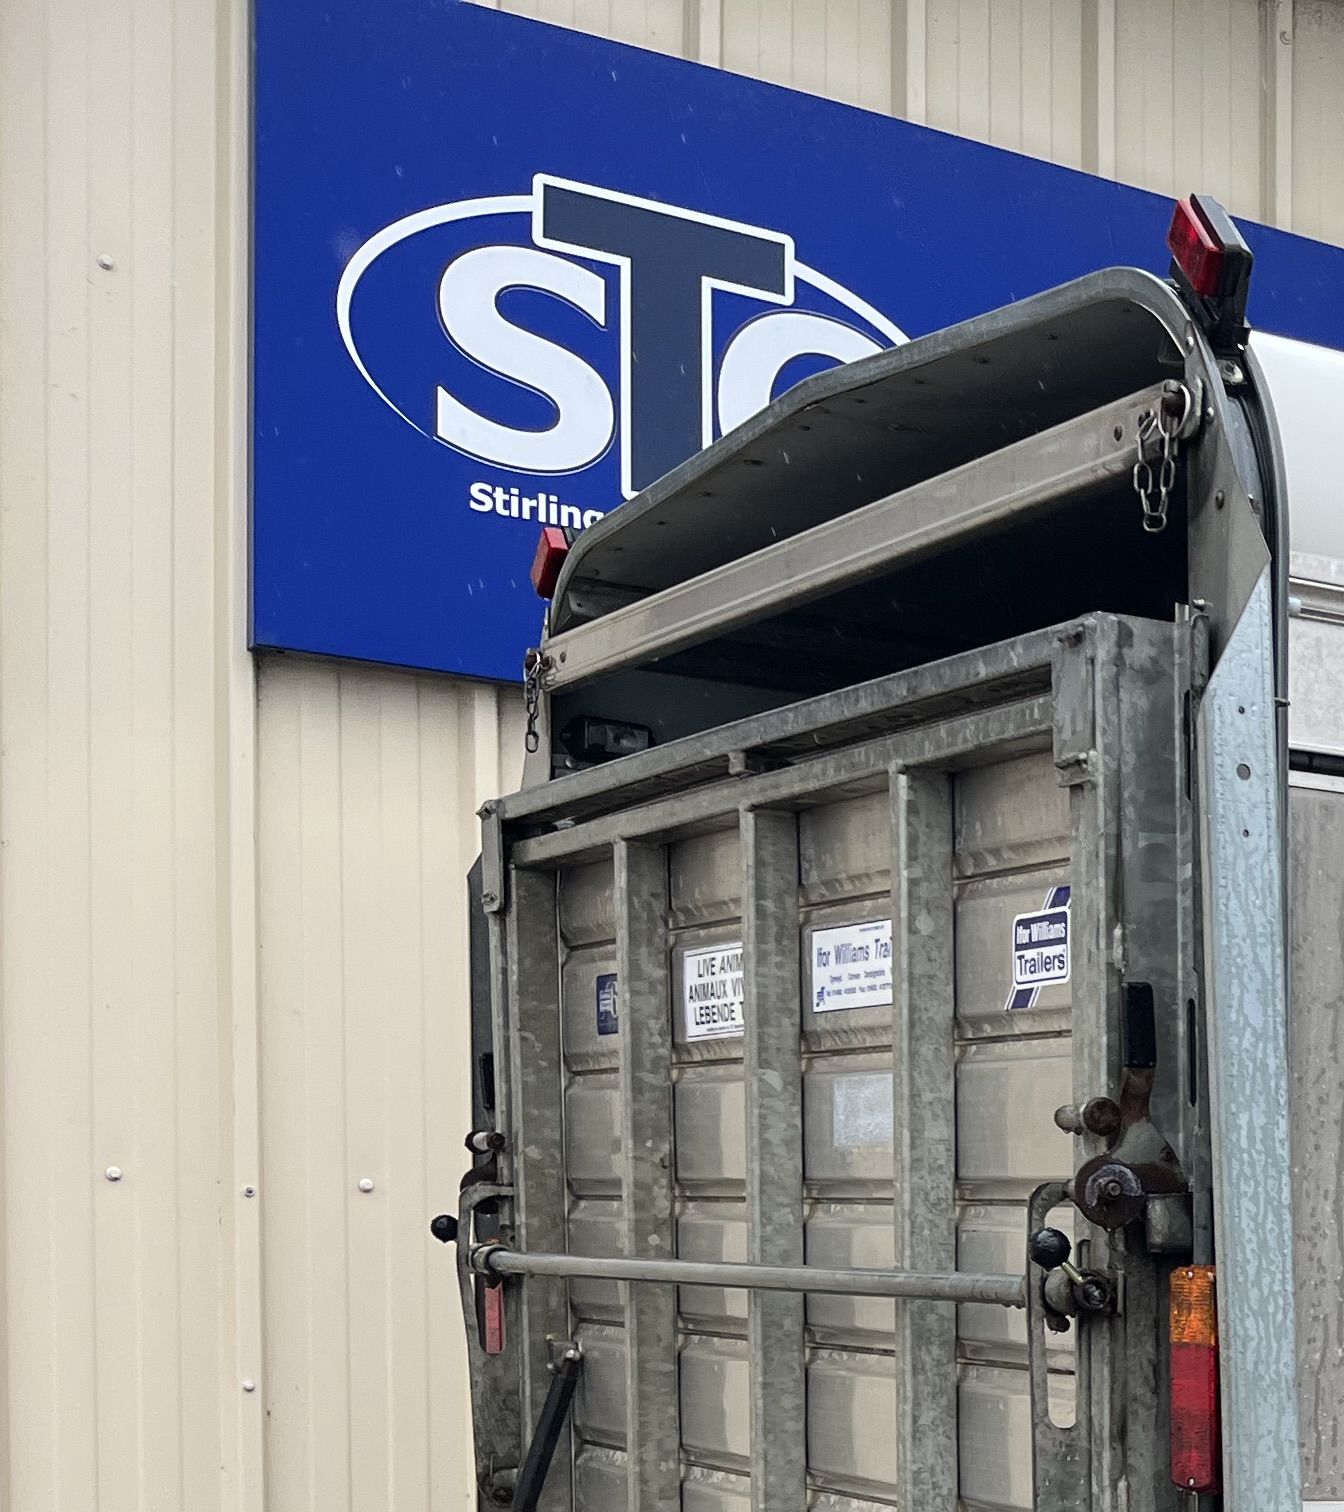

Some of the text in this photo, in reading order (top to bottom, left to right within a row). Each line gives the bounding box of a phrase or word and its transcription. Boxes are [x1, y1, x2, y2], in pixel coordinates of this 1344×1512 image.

[1016, 921, 1066, 945] Ifor Williams
[834, 942, 870, 965] Williams
[1017, 951, 1065, 976] Trailers
[697, 957, 717, 978] LIVE
[688, 980, 728, 1004] ANIMAUX
[694, 1002, 736, 1026] LEBENDE
